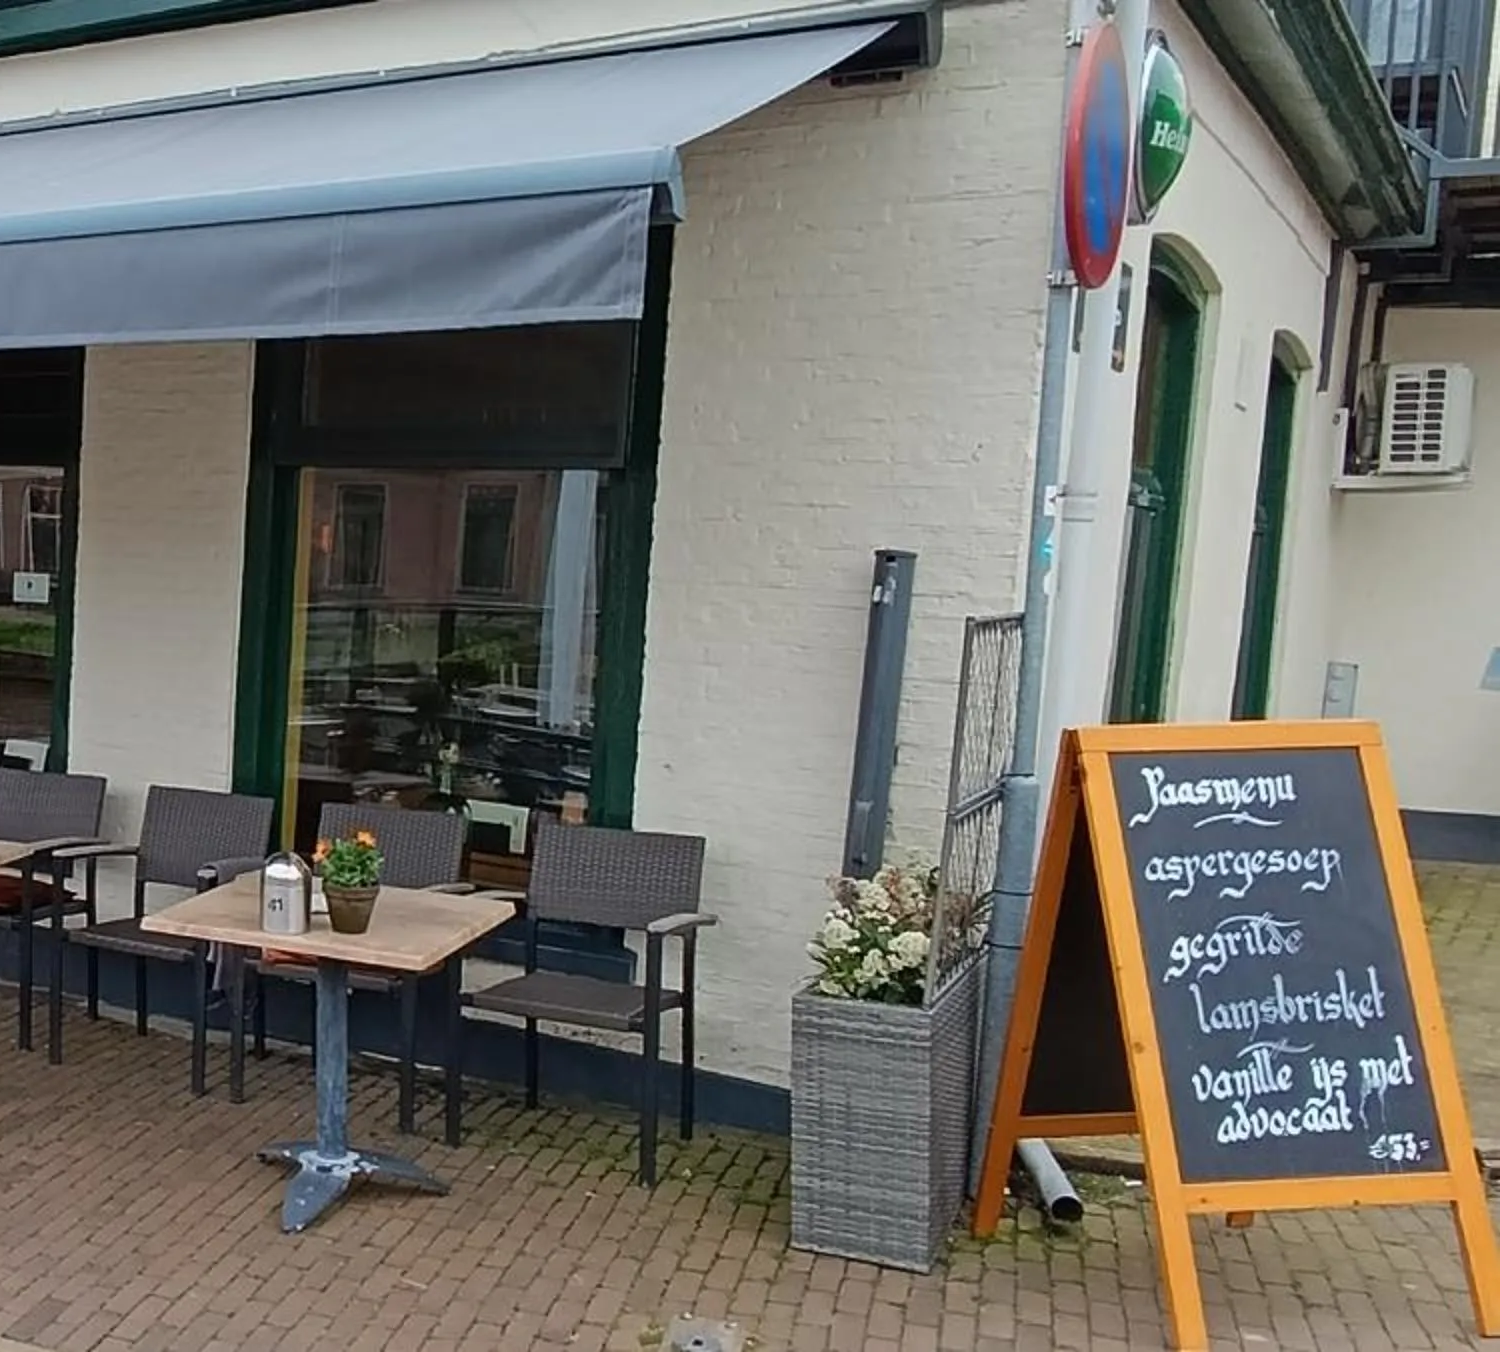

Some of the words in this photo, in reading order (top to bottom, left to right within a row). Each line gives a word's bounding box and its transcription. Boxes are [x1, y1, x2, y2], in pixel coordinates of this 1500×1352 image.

[1128, 765, 1298, 829] Paasmenu
[1144, 847, 1341, 900] aspergesoep
[1163, 914, 1304, 983] gegrilde
[1188, 964, 1386, 1036] lamsbrisket
[1191, 1047, 1294, 1107] vanille
[1358, 1034, 1414, 1092] met
[1216, 1089, 1354, 1144] advocaat
